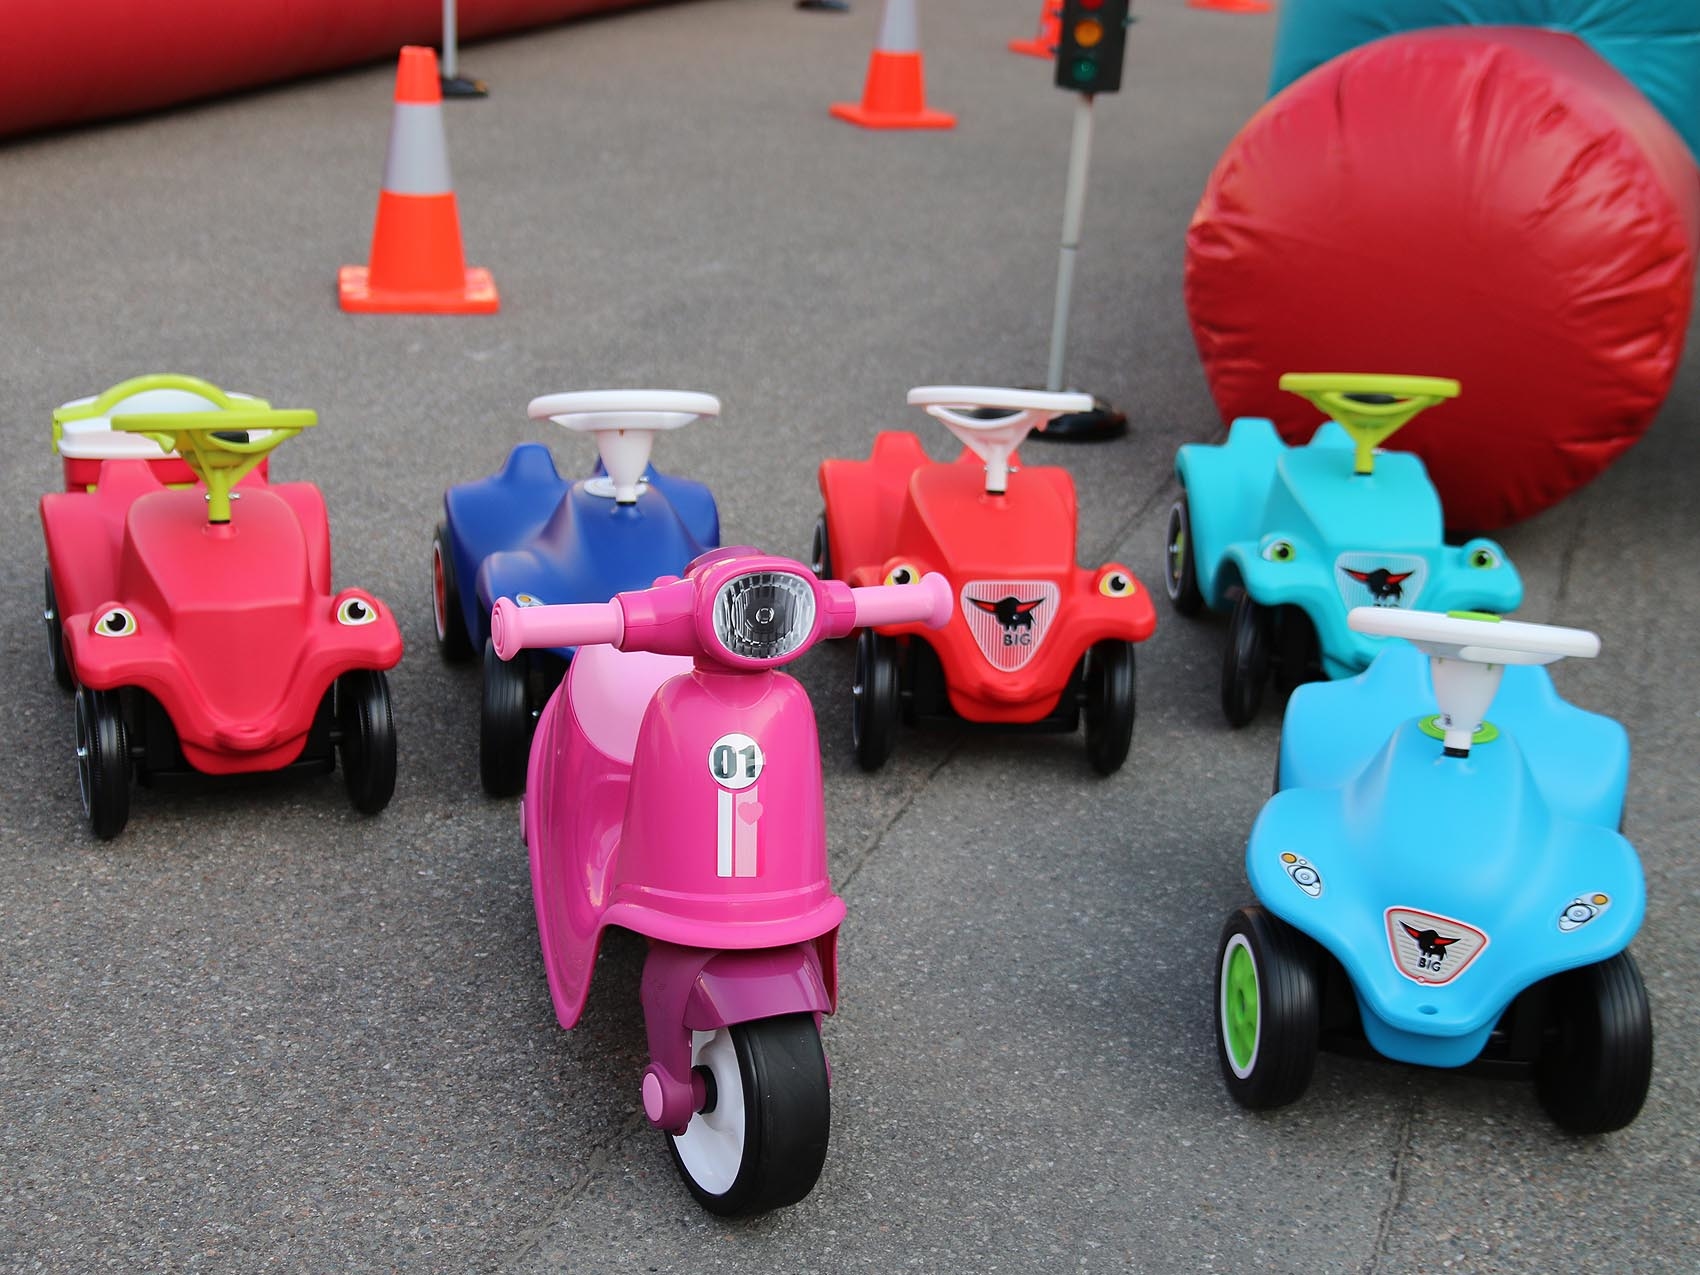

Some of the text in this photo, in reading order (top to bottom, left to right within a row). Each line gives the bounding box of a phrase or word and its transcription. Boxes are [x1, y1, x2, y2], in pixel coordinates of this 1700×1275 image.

[1003, 633, 1031, 646] BIG
[713, 744, 756, 779] 01
[1418, 957, 1441, 972] BIG
